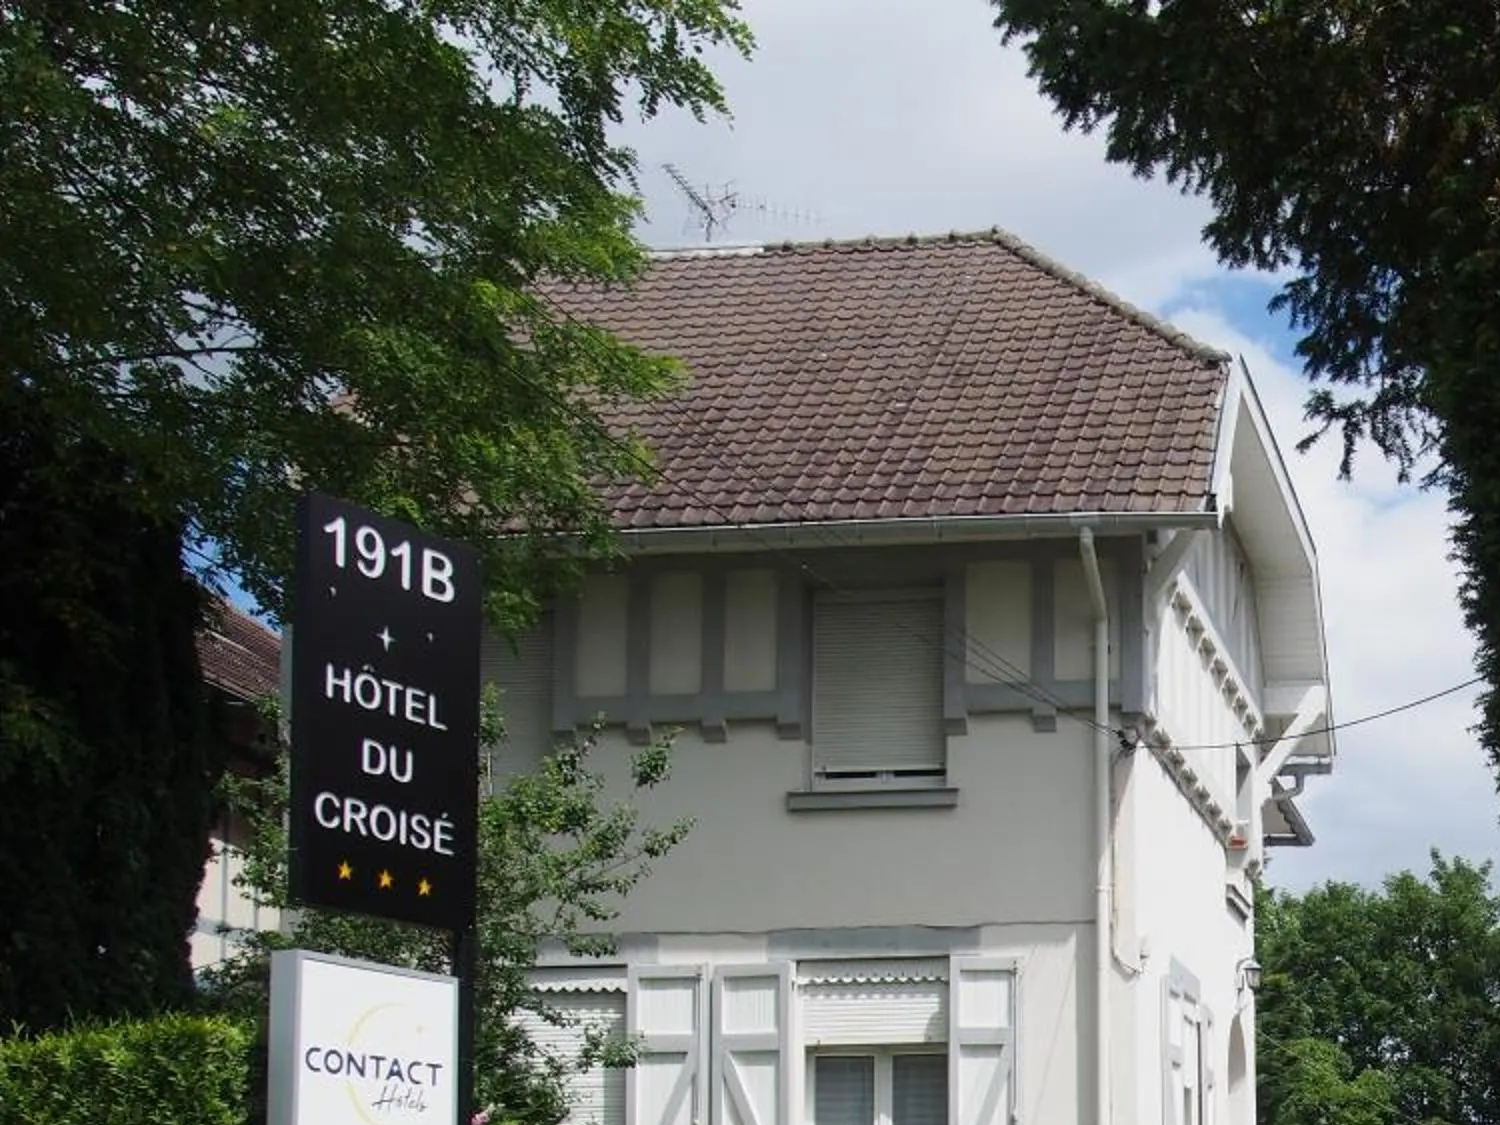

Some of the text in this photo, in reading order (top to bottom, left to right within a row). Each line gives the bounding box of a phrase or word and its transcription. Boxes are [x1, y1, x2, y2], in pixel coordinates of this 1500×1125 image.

[323, 516, 456, 604] 191B
[325, 662, 449, 731] HÔTEL
[361, 738, 413, 784] DU
[314, 791, 456, 856] CROISÉ
[305, 1046, 443, 1087] CONTACT
